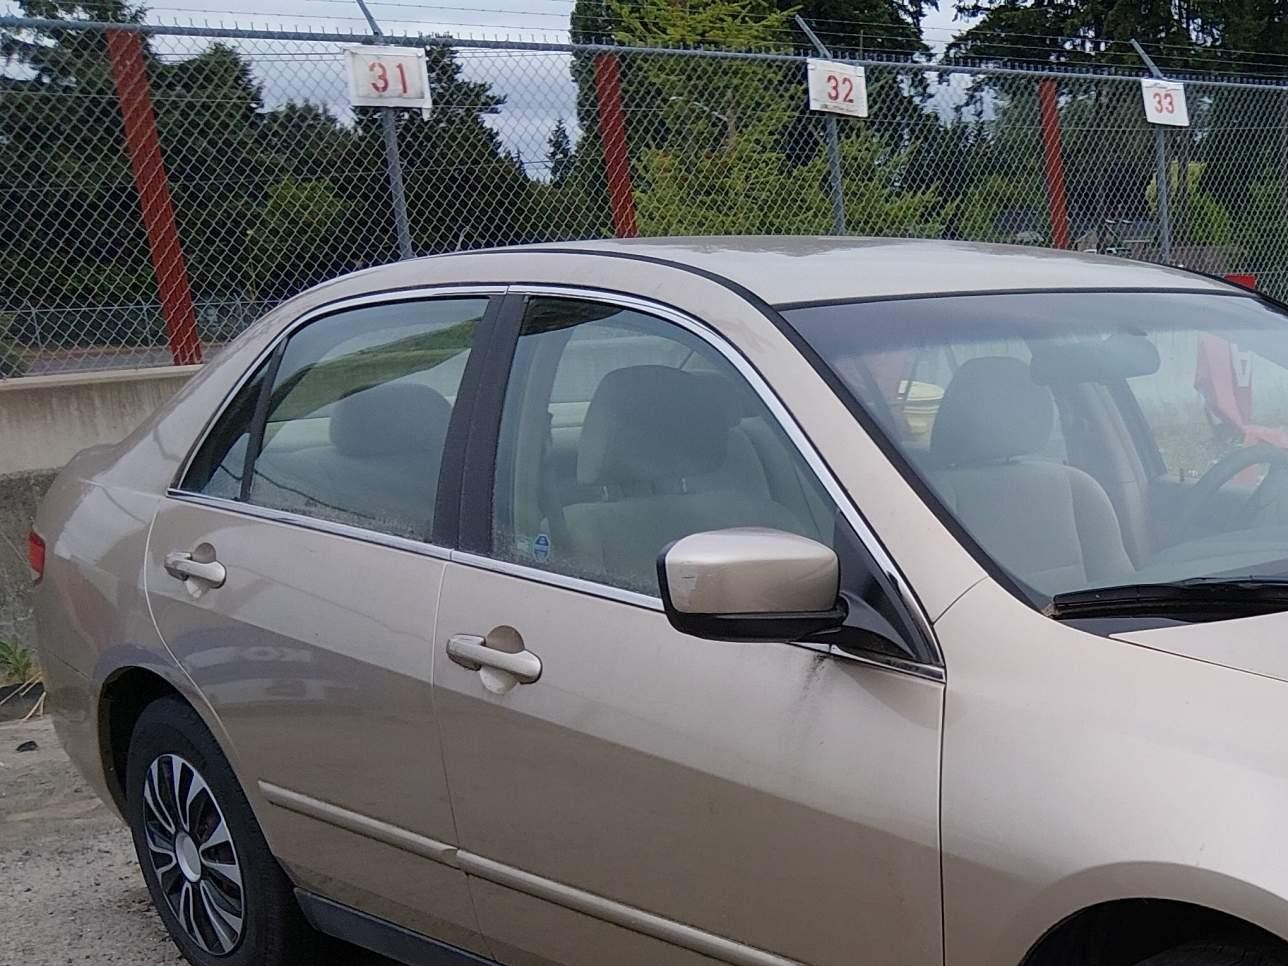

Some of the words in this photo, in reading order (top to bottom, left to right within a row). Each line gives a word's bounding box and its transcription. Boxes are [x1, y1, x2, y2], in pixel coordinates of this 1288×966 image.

[369, 62, 408, 94] 31
[827, 74, 855, 104] 32
[1153, 92, 1175, 114] 33
